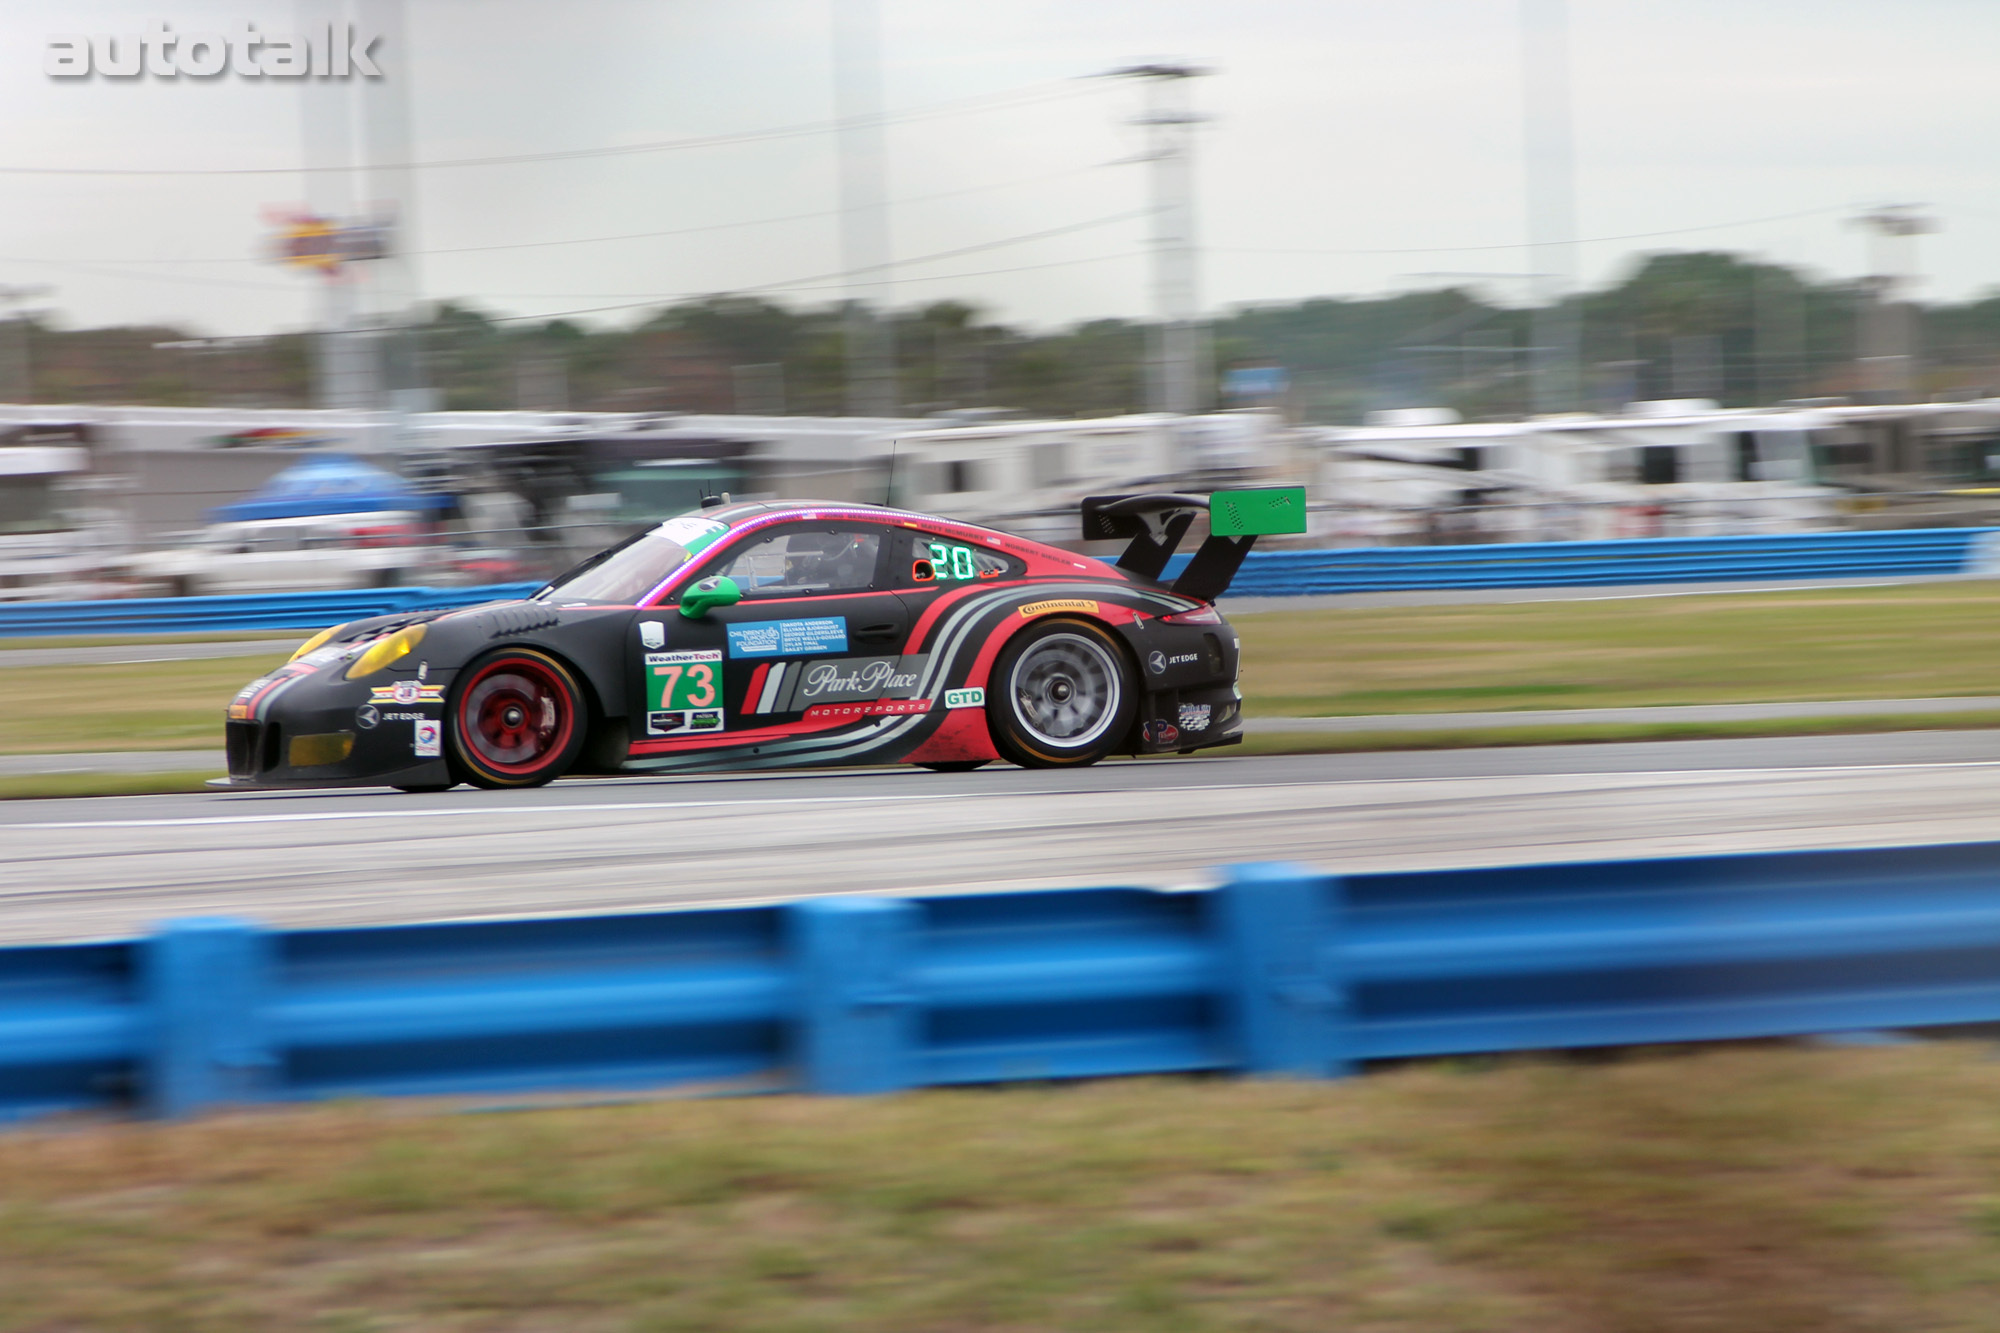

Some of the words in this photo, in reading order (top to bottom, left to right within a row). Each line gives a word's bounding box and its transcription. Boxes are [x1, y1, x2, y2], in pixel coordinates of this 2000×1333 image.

[929, 543, 974, 580] 20
[1022, 600, 1086, 614] Continental
[648, 652, 719, 663] WeatherTech
[1169, 656, 1180, 664] JET
[1181, 653, 1198, 662] EDGE
[803, 664, 859, 696] Park
[857, 661, 917, 692] Place
[653, 664, 716, 708] 73
[947, 690, 982, 705] GTD
[810, 703, 926, 716] MOTORSPORTS
